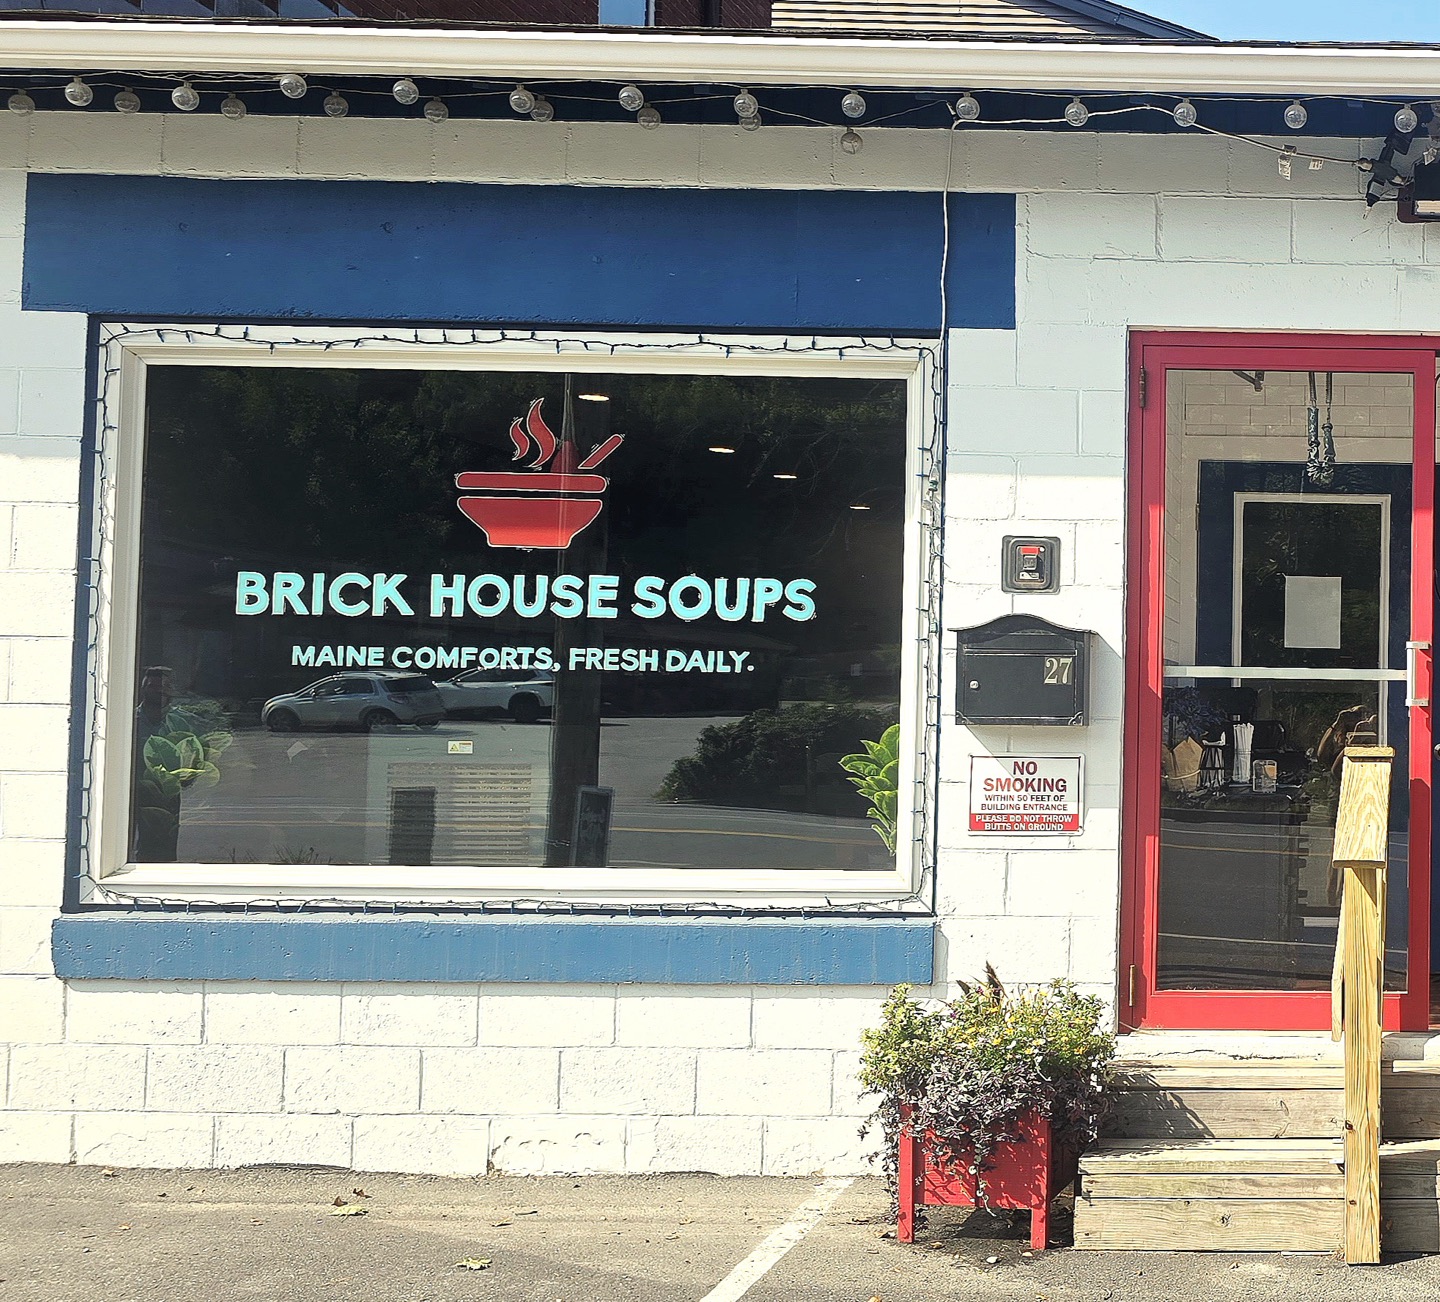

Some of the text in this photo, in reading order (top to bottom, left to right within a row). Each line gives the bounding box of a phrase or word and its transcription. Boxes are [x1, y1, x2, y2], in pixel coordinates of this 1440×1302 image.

[235, 571, 818, 623] BRICK HOUSE SOUPS
[291, 645, 755, 674] MAINE COMFORTS, FRESH DAILY.
[1044, 657, 1072, 684] 27
[1013, 761, 1038, 776] NO
[983, 777, 1067, 793] SMOKING
[985, 794, 1014, 802] WITHIN
[1017, 794, 1028, 802] 50
[981, 803, 1068, 811] BUILDING ENTRANCE
[975, 814, 1007, 822] PLEASE
[1023, 815, 1041, 823] NOT
[1042, 815, 1073, 823] THROW
[984, 823, 1064, 831] BUTTS ON GROUND
